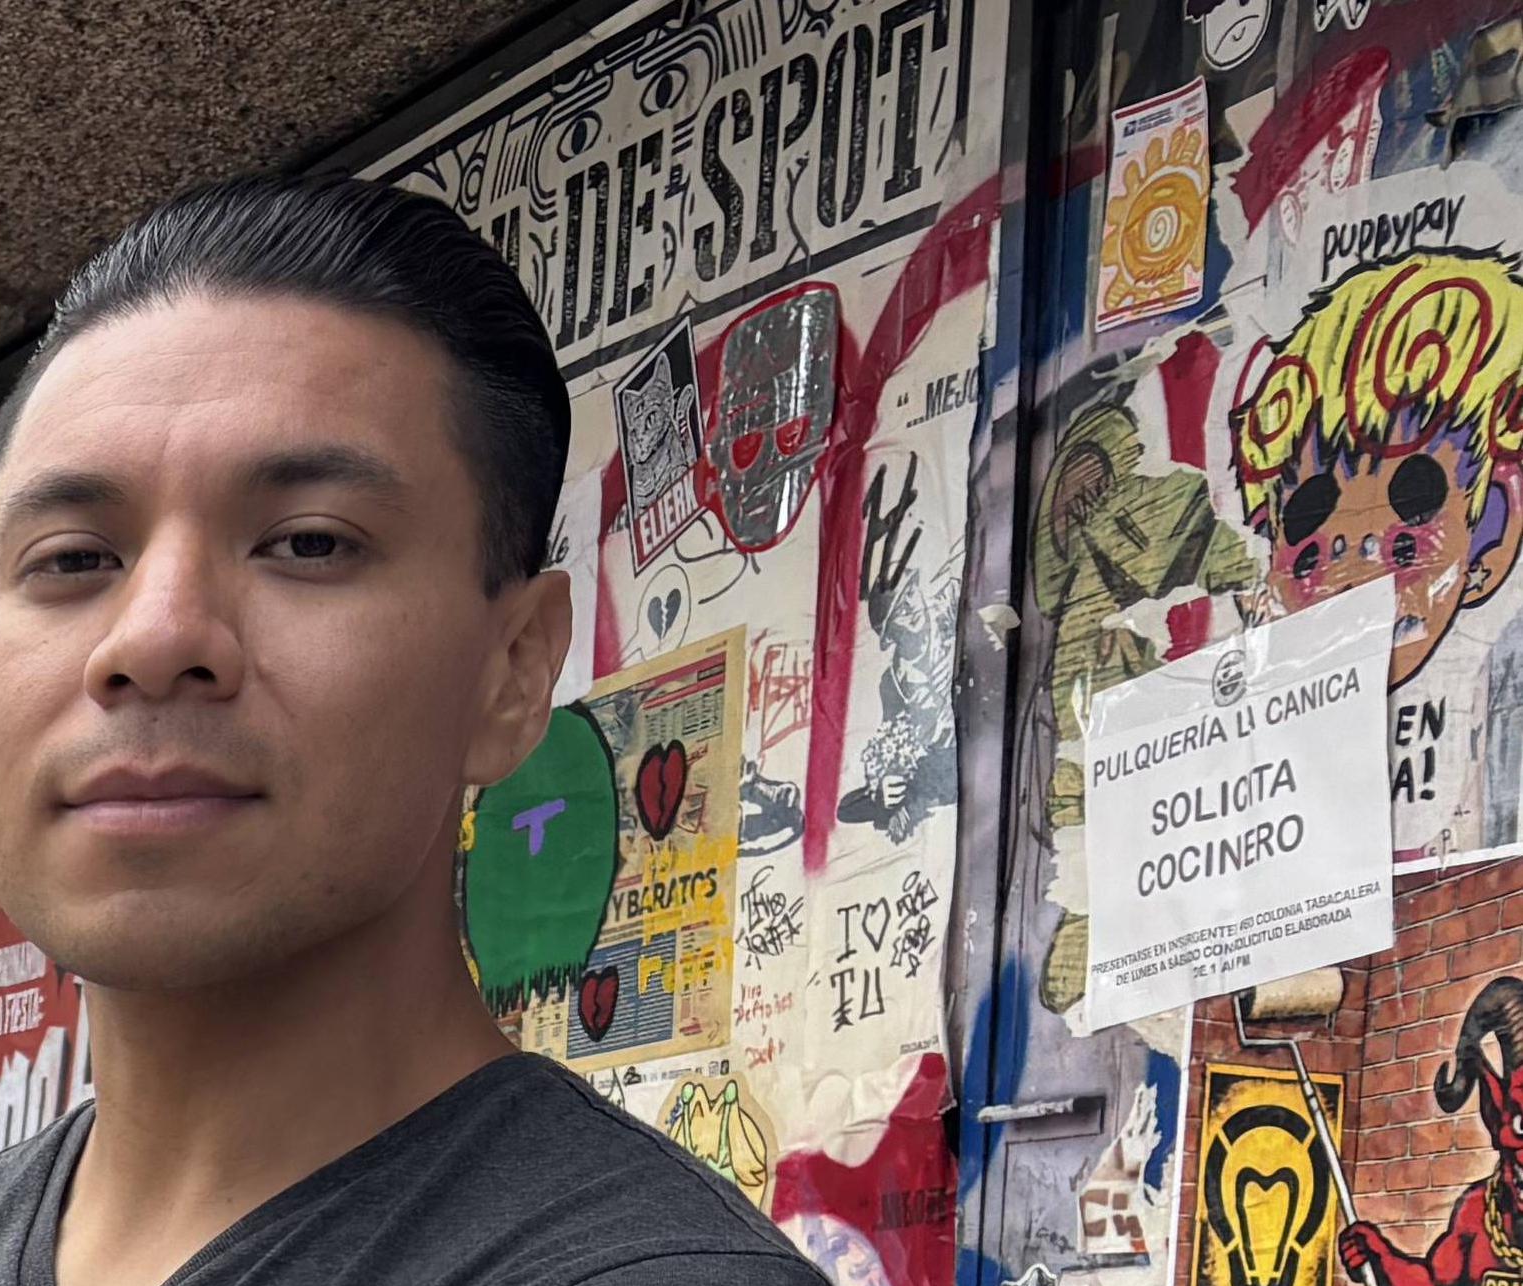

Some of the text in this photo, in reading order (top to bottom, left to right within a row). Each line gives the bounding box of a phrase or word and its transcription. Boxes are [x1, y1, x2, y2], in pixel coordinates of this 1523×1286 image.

[693, 0, 951, 282] SPOT
[1092, 715, 1228, 787] PULQUERÍA
[1265, 666, 1361, 725] CANICA
[1152, 758, 1296, 836] SOLICITA
[1137, 813, 1304, 897] COCINERO
[1305, 881, 1381, 911] TABACALERA
[1116, 971, 1129, 986] DE
[1284, 908, 1352, 937] ELABORADA
